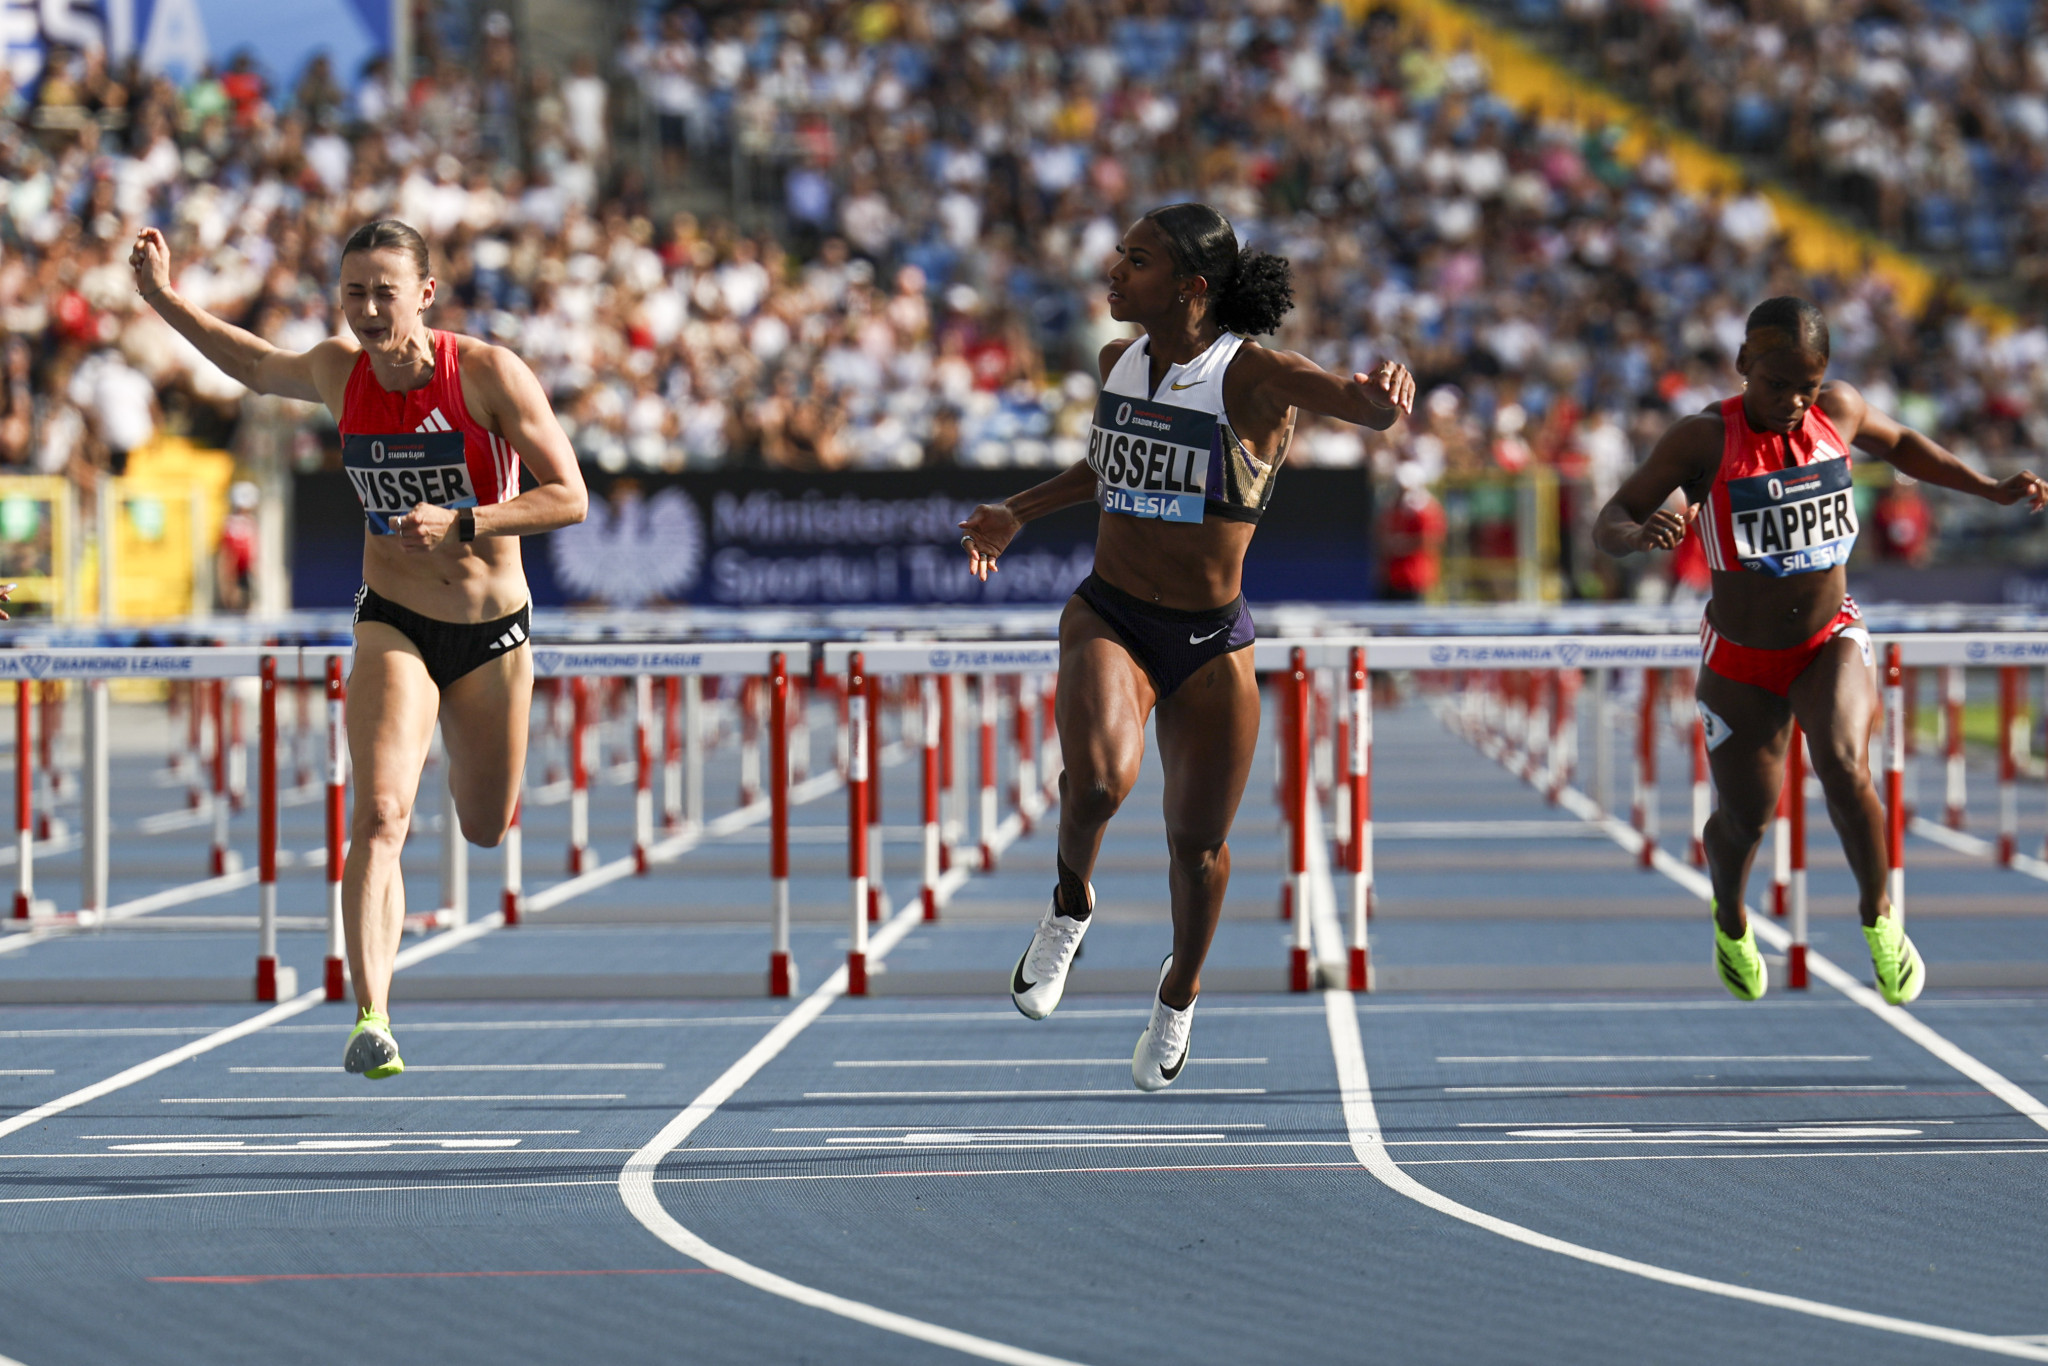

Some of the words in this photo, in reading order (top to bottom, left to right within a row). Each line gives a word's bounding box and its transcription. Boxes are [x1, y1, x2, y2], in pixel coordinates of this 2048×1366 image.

[1088, 428, 1201, 494] RUSSELL
[349, 467, 469, 511] VISSER
[1106, 490, 1182, 517] SILESIA
[1737, 492, 1855, 556] TAPPER
[1781, 543, 1848, 573] SILESIA
[52, 656, 128, 674] DIAMOND
[130, 655, 193, 671] LEAGUE
[564, 653, 639, 669] DIAMOND
[642, 652, 702, 668] LEAGUE
[1585, 645, 1657, 660] DIAMOND
[1661, 645, 1702, 660] LEAG
